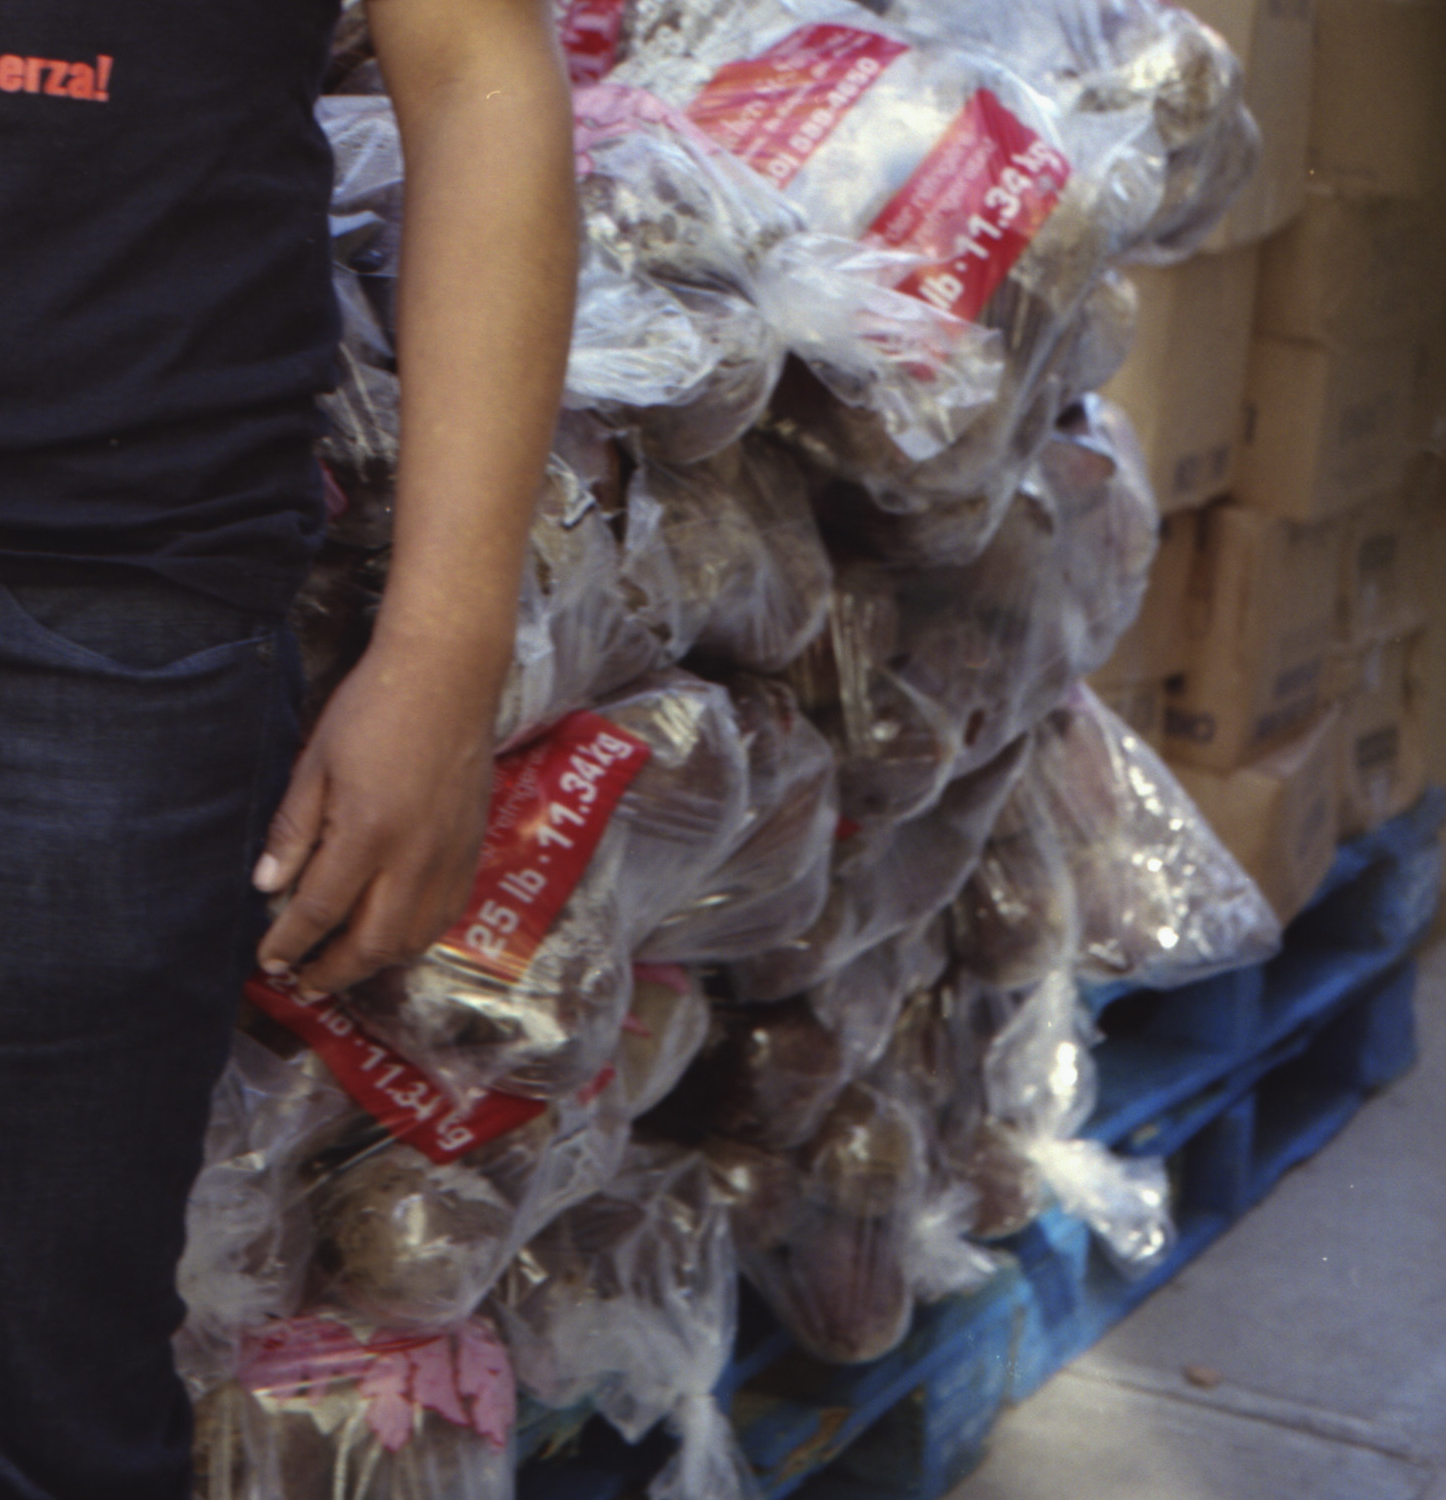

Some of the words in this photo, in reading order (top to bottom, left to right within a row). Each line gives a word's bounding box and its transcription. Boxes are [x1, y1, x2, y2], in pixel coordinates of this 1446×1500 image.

[918, 272, 965, 311] lb
[465, 900, 519, 960] 25
[498, 868, 547, 904] lb
